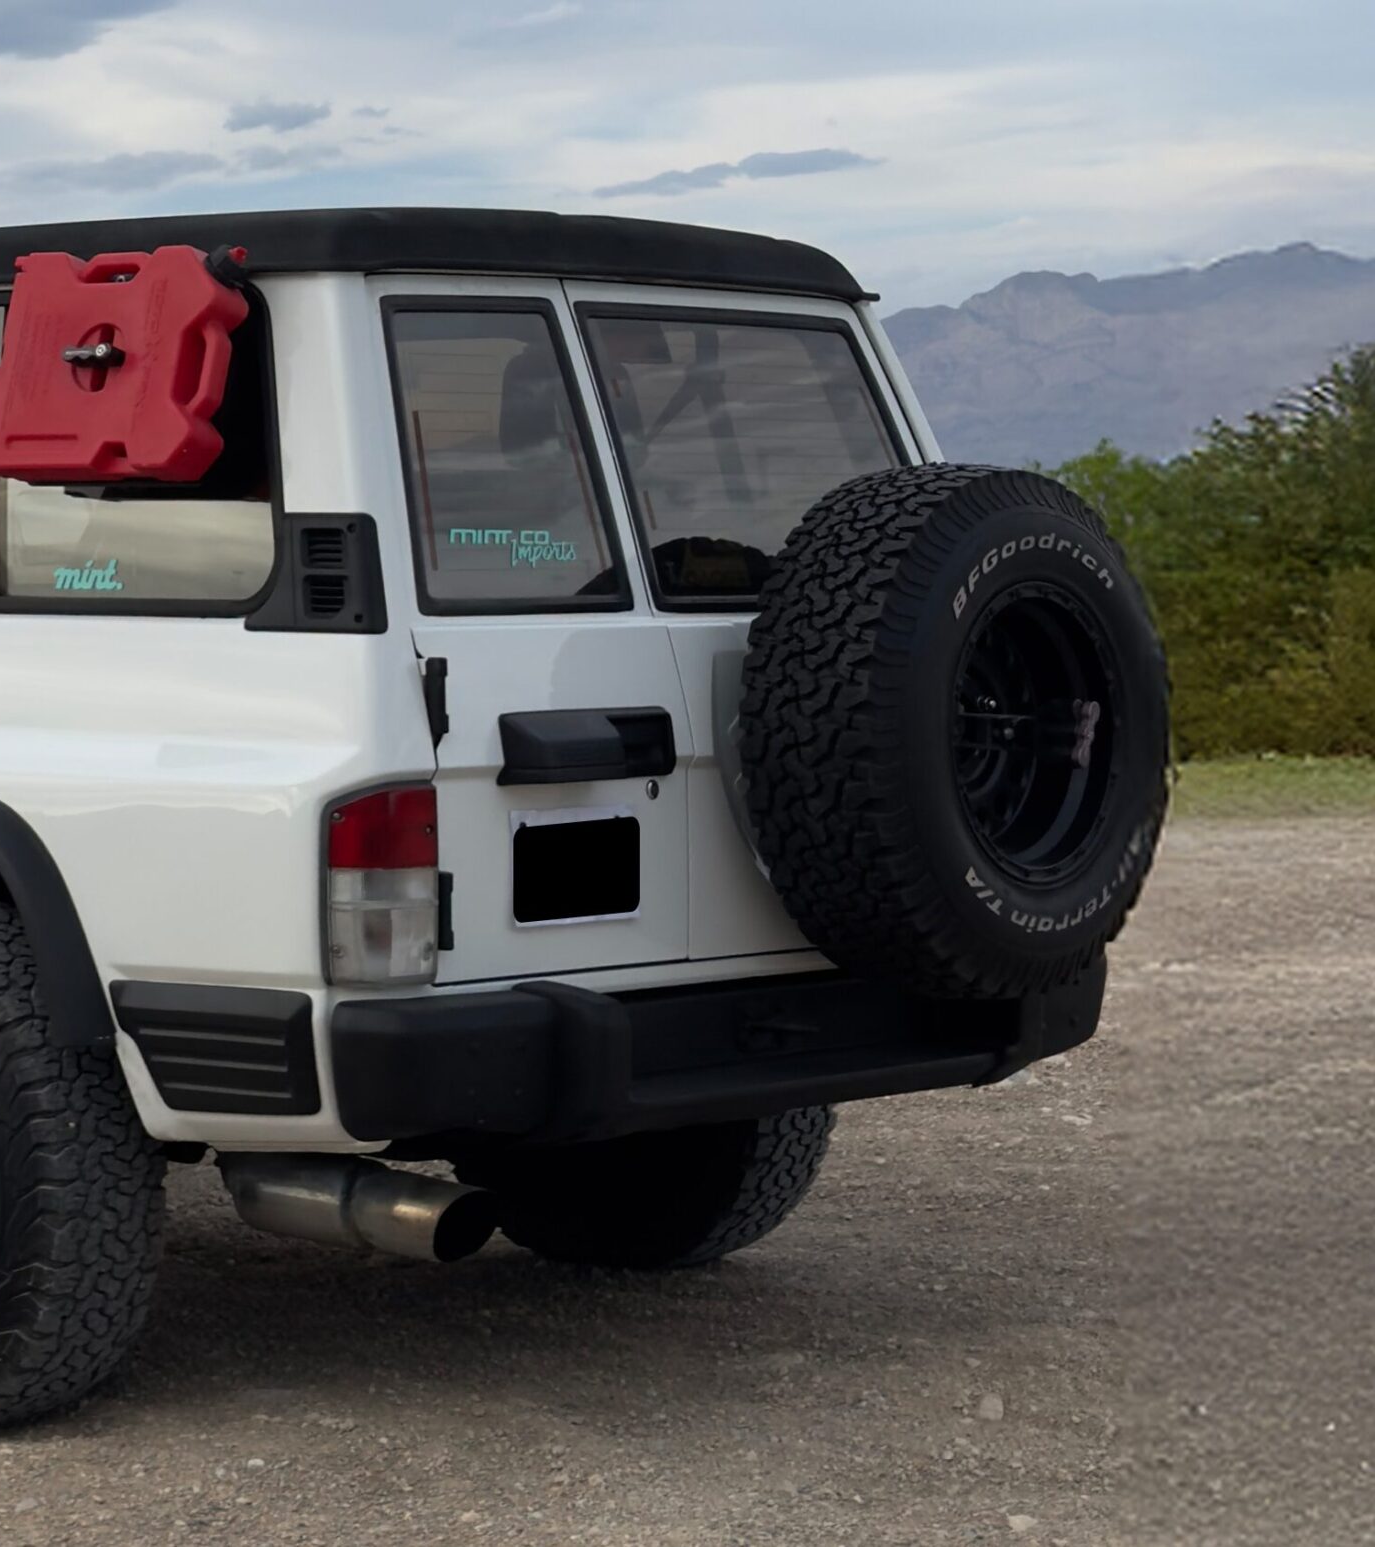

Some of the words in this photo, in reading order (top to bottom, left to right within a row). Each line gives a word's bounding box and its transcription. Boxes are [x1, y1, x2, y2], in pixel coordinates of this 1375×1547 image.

[510, 538, 576, 569] Imports
[952, 532, 1115, 620] BFGoodrich
[964, 867, 1003, 916] T/A
